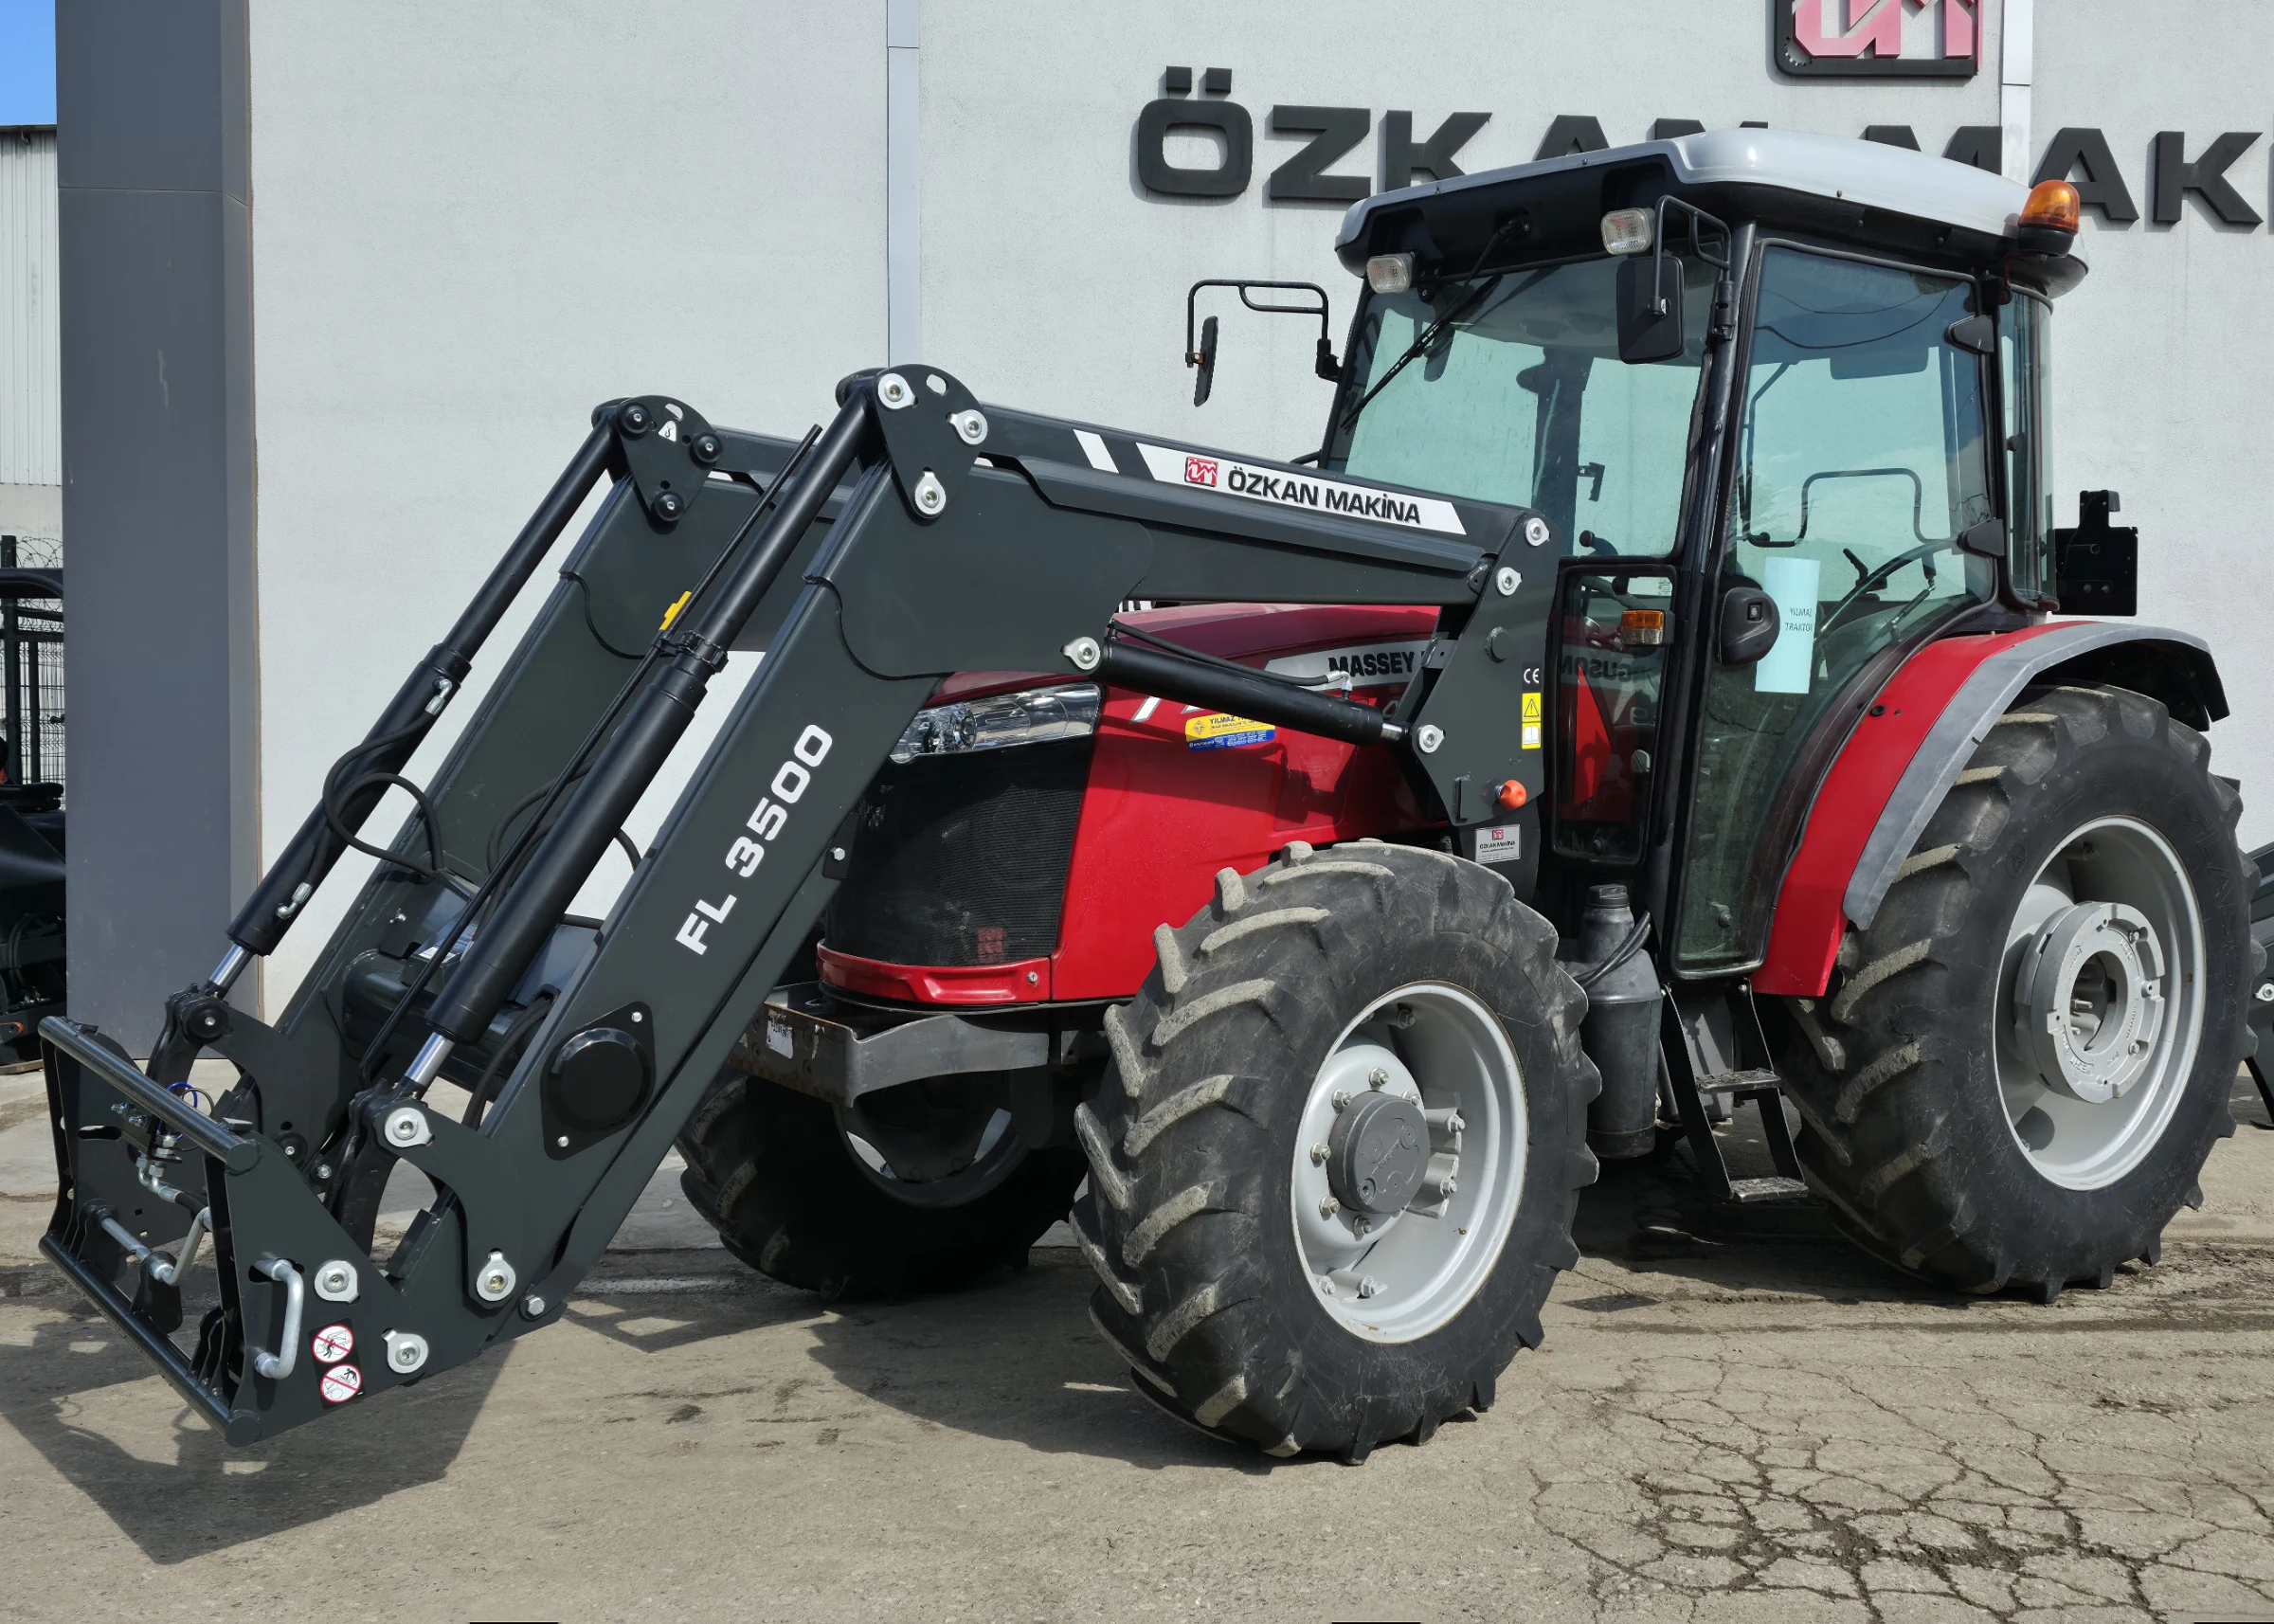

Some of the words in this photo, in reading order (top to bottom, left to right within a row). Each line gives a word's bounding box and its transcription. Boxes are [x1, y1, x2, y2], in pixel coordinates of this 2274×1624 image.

[1138, 65, 1768, 200] ÖZK
[1228, 465, 1319, 506] ÖZKAN
[1326, 487, 1421, 525] MAKİNA
[1328, 652, 1415, 677] MASSEY
[675, 894, 737, 956] FL
[725, 724, 833, 877] 3500
